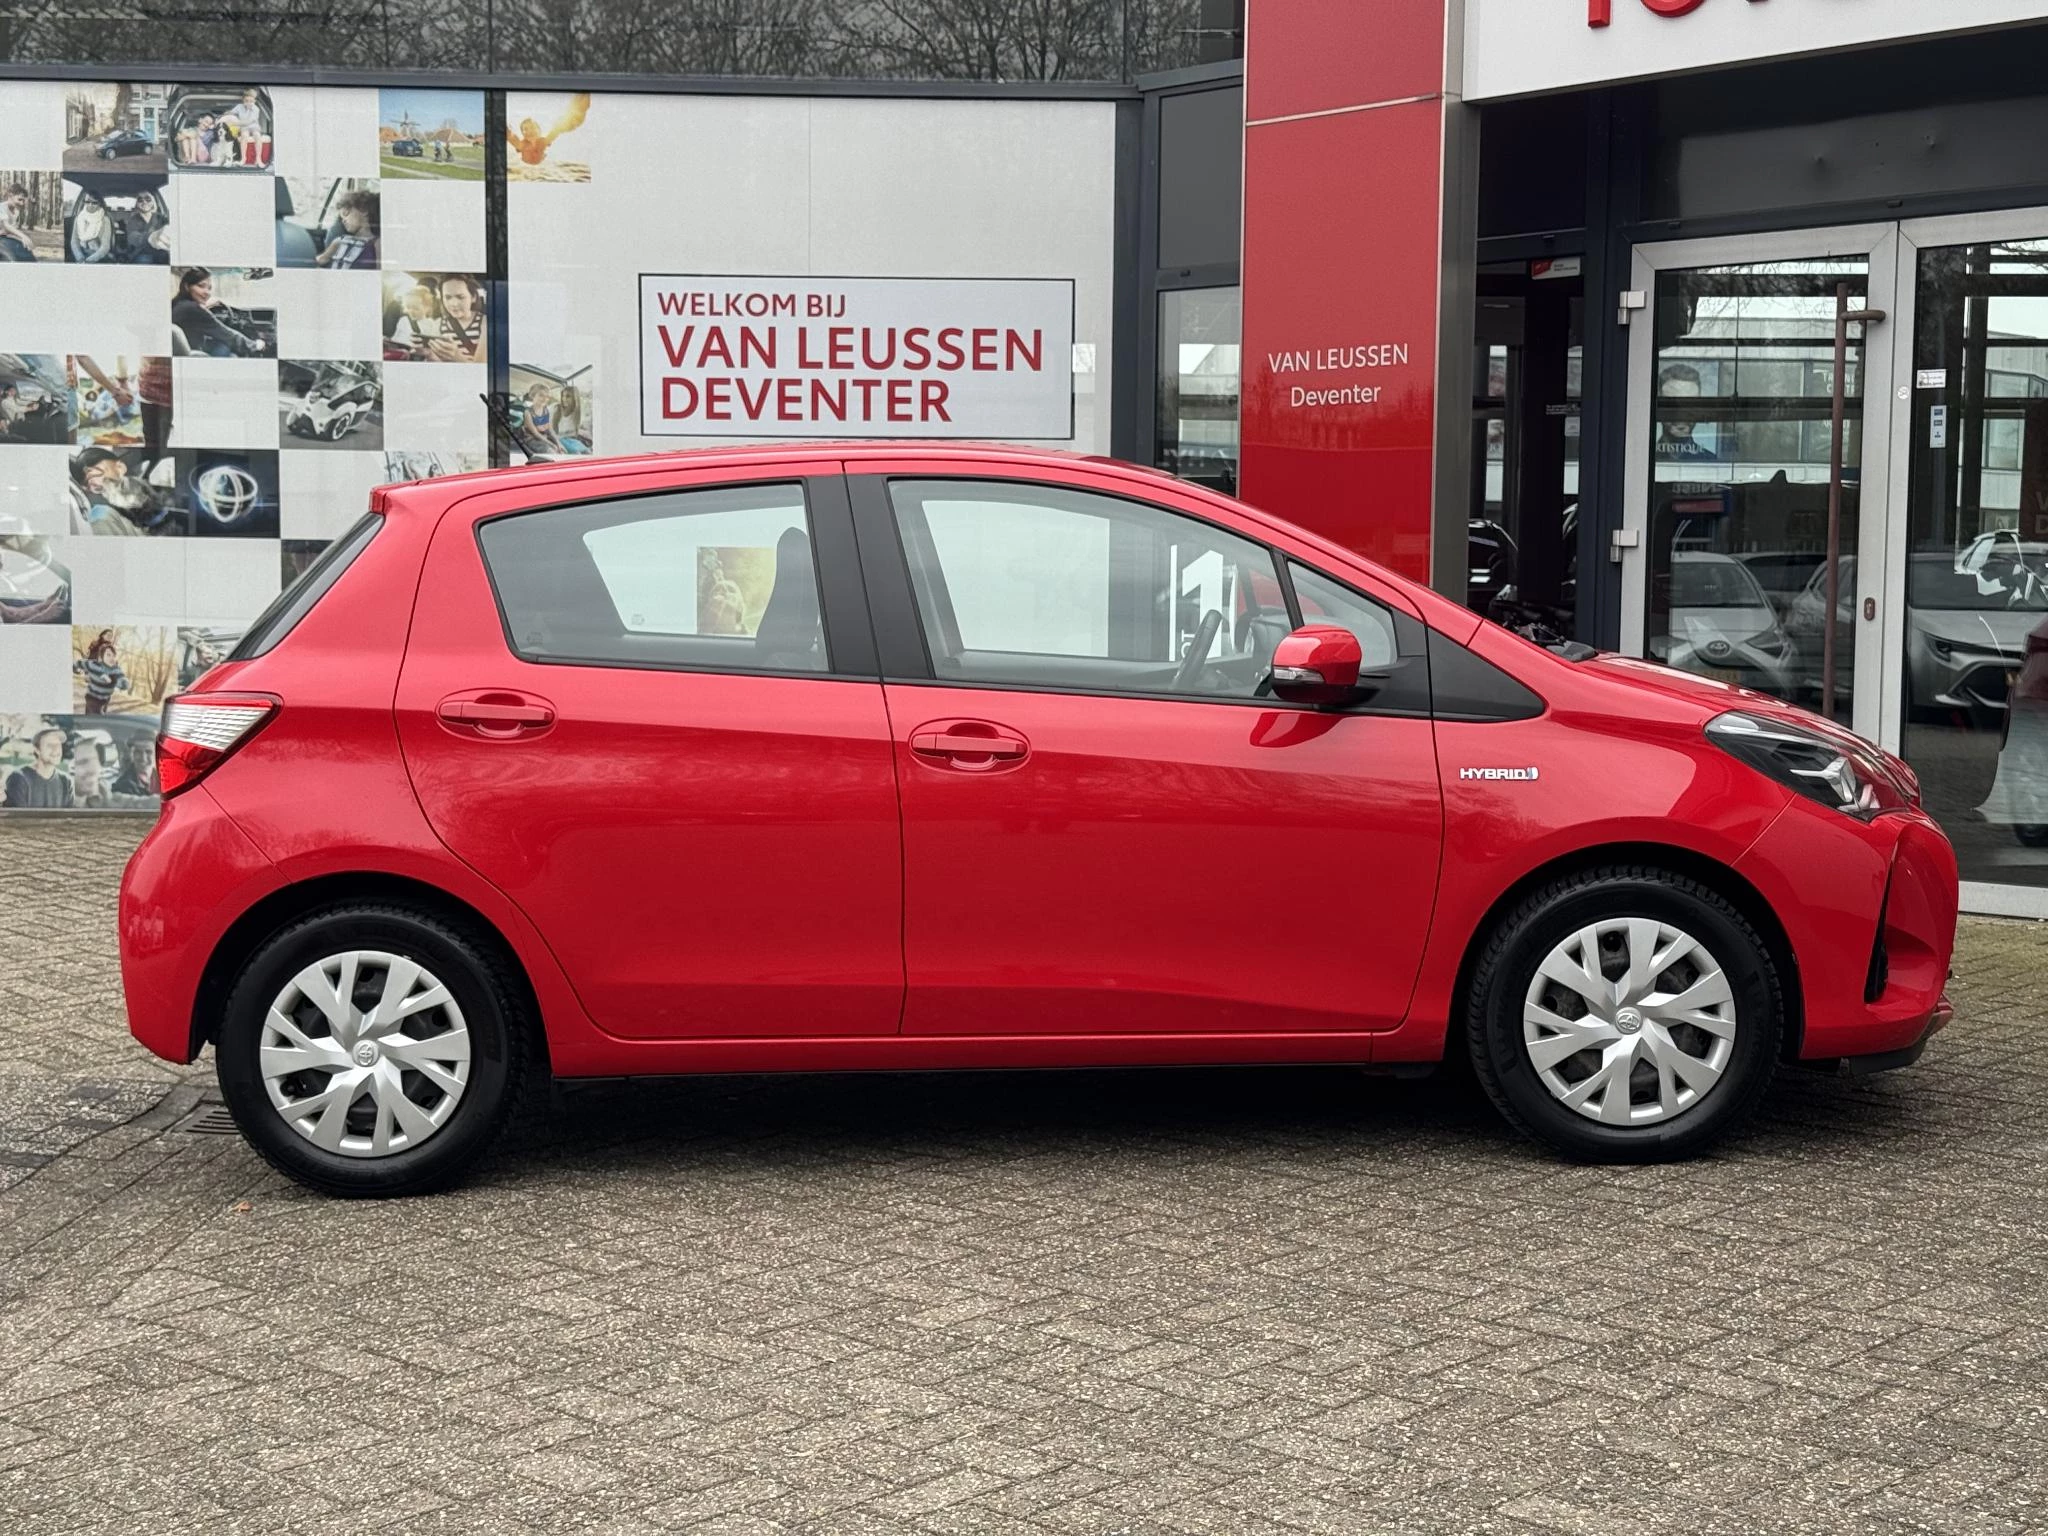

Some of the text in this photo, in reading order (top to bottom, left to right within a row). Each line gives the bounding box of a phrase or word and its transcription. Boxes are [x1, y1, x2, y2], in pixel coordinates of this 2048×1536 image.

[657, 292, 846, 318] WELKOM BIJ
[657, 325, 1042, 371] VAN LEUSSEN
[1267, 342, 1409, 373] VAN LEUSSEN
[662, 377, 952, 422] DEVENTER
[1290, 384, 1382, 407] Deventer
[1459, 767, 1527, 780] HYBRID
